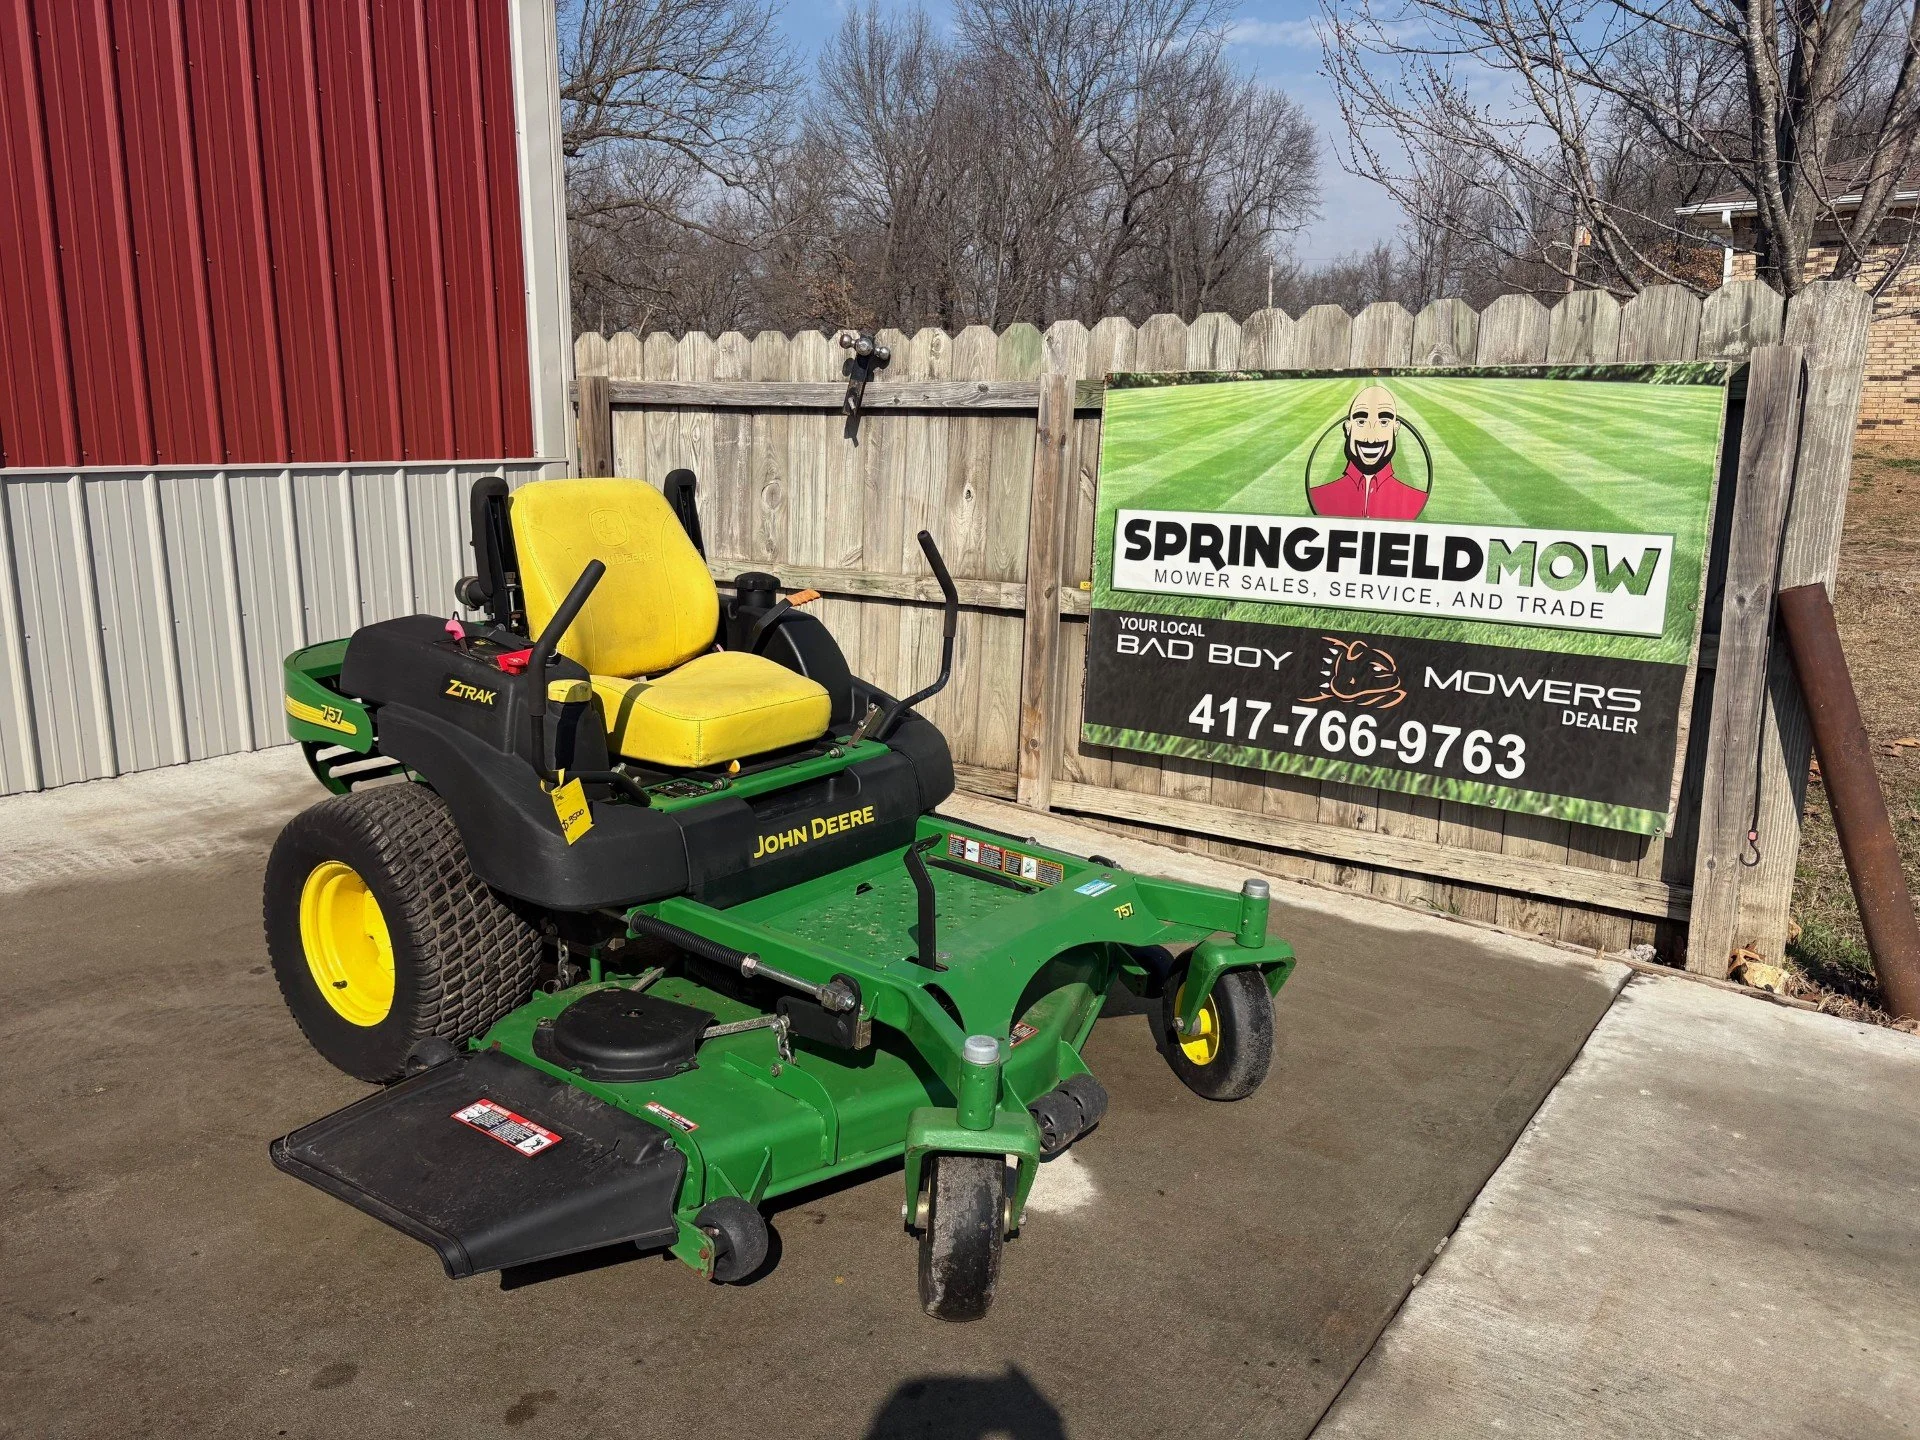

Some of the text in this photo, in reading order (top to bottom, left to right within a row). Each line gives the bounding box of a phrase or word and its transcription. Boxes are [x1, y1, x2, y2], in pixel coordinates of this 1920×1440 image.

[1154, 568, 1605, 619] MOWER SALES, SERVICE, AND TRADE
[1119, 616, 1205, 637] YOUR LOCAL
[1116, 634, 1642, 713] BAD BOY MOWERS
[320, 704, 343, 725] 757
[1561, 709, 1639, 735] DEALER
[1188, 693, 1526, 780] 417-766-9763
[753, 805, 875, 859] JOHN DEERE
[1113, 902, 1135, 920] 757
